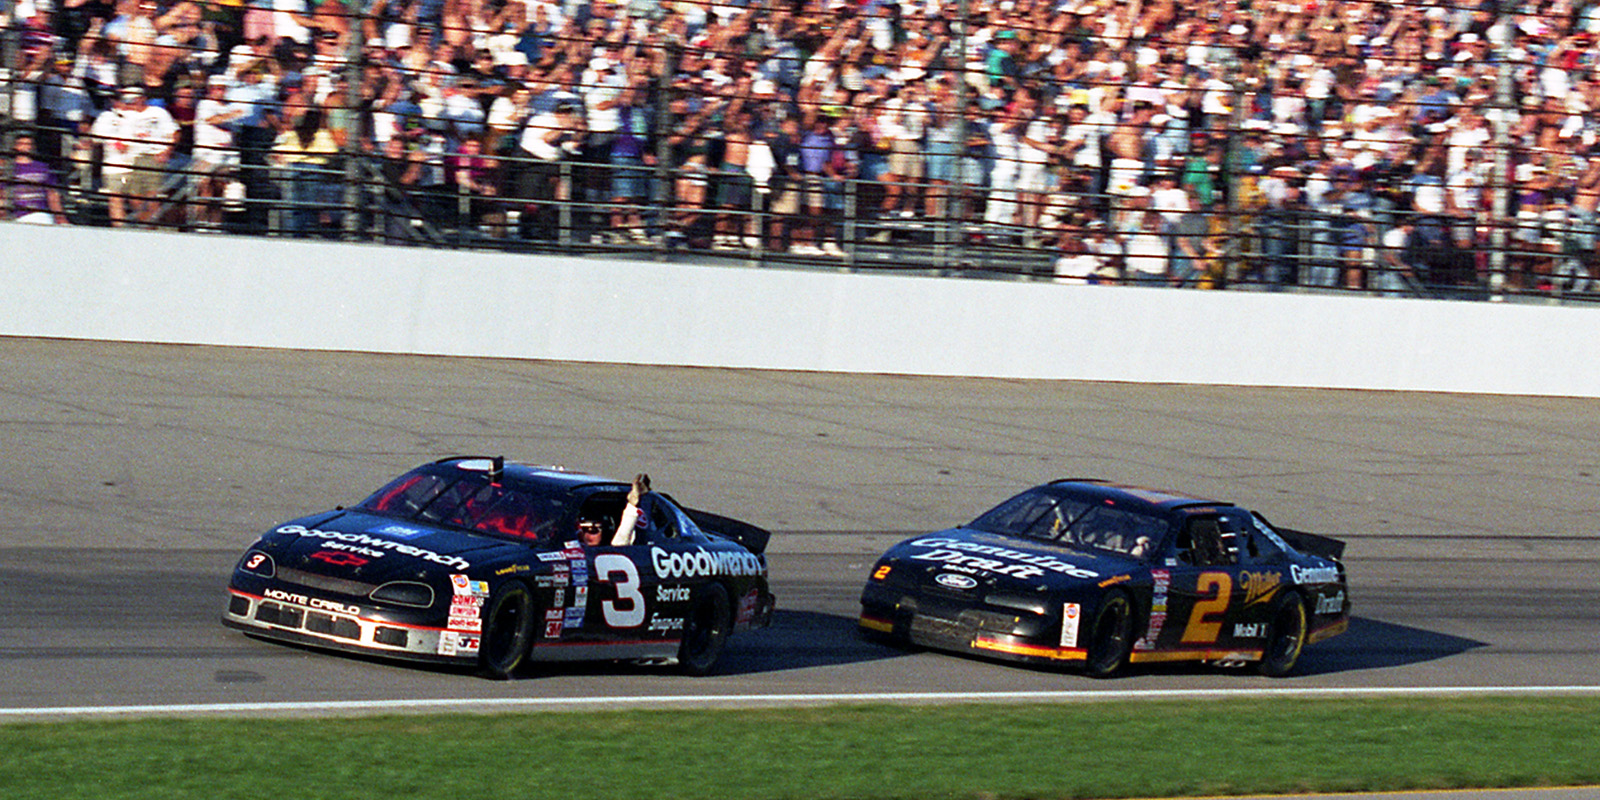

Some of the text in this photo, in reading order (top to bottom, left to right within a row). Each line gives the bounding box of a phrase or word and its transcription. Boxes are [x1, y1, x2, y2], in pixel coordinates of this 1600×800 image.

[247, 555, 266, 569] 3
[277, 525, 470, 570] Goodwrench
[321, 541, 385, 558] Service
[651, 545, 763, 579] Goodwrench
[910, 538, 1099, 579] Genuine
[874, 566, 892, 580] 2
[910, 549, 1045, 579] Draft
[264, 588, 361, 615] MONTE CARLO
[594, 554, 646, 627] 3
[656, 584, 691, 602] Service
[1181, 571, 1233, 643] 2
